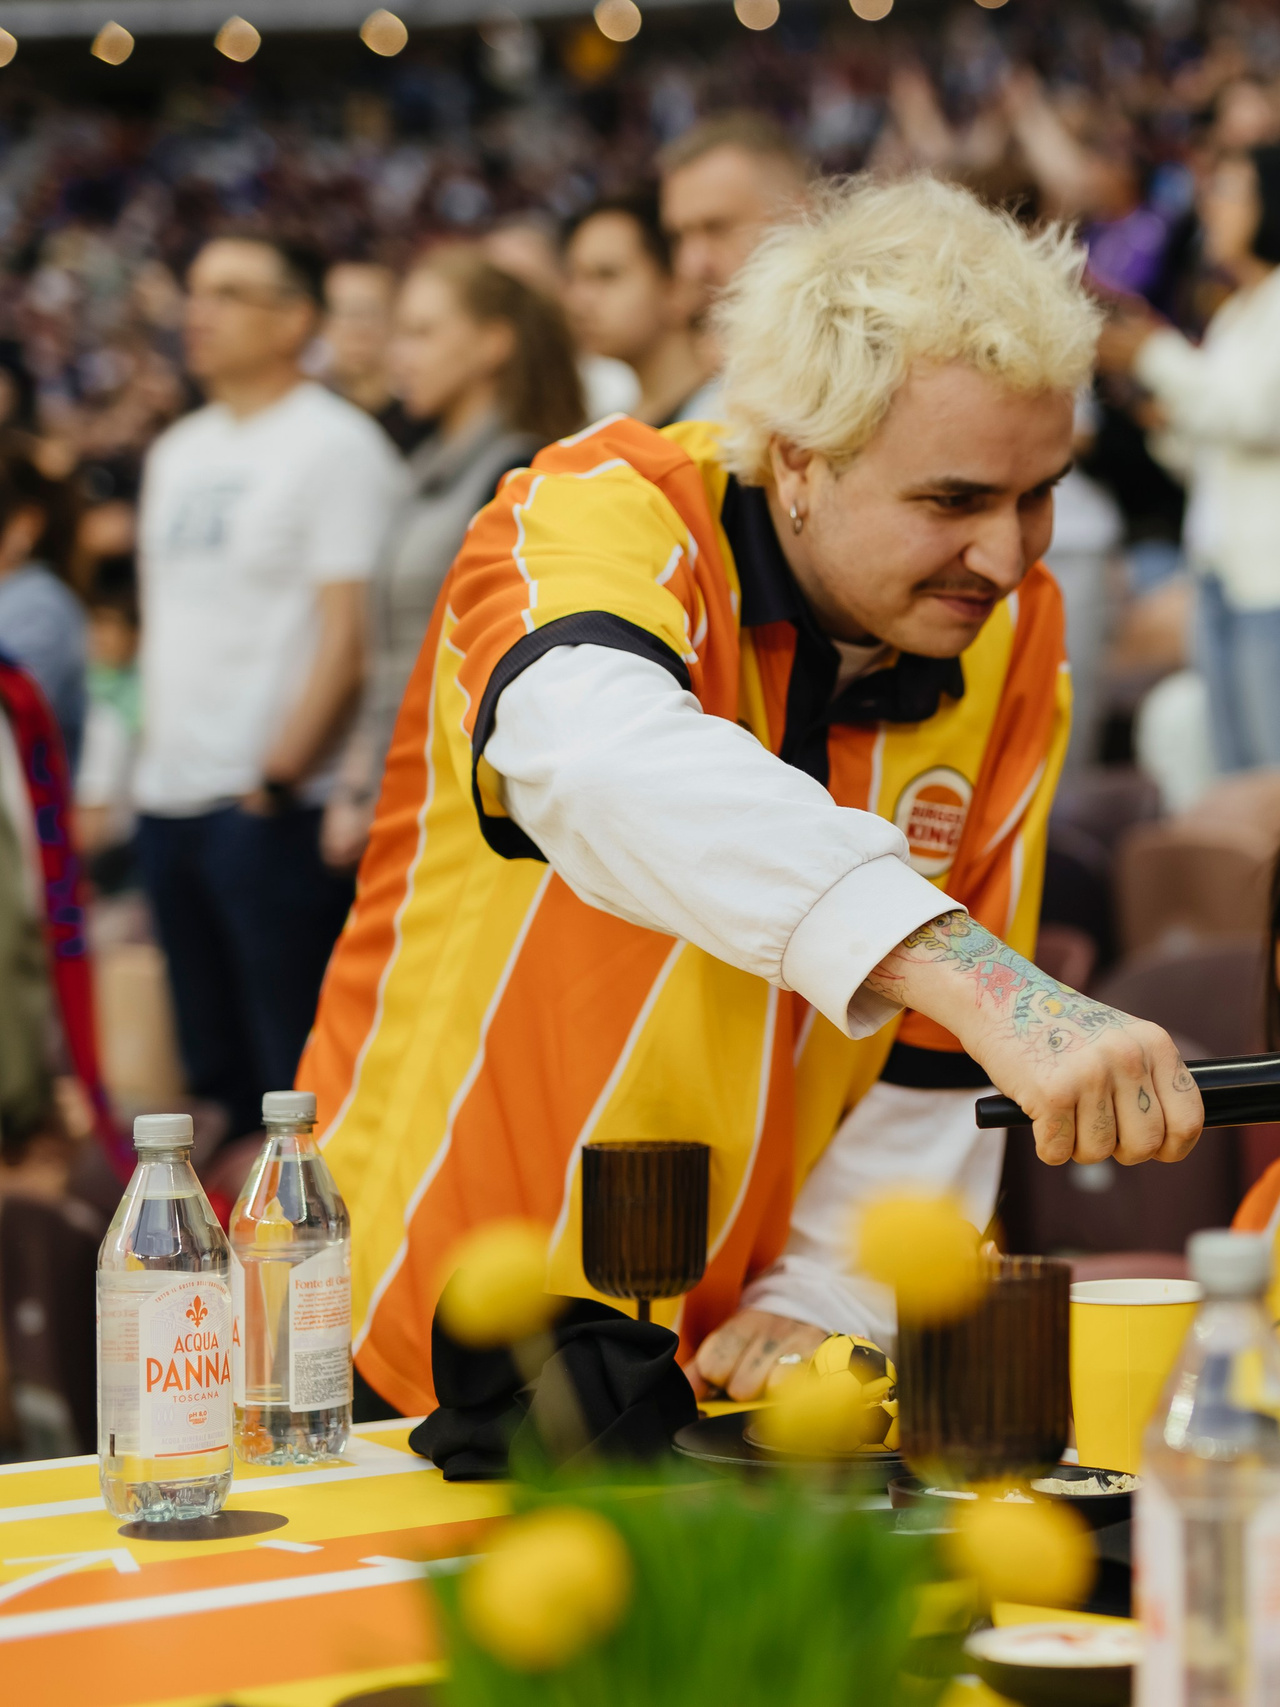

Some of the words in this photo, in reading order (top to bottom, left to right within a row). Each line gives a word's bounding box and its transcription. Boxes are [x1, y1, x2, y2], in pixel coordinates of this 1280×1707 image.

[173, 1331, 219, 1354] ACQUA
[146, 1351, 231, 1392] PANNA
[173, 1391, 219, 1403] TOSCANA
